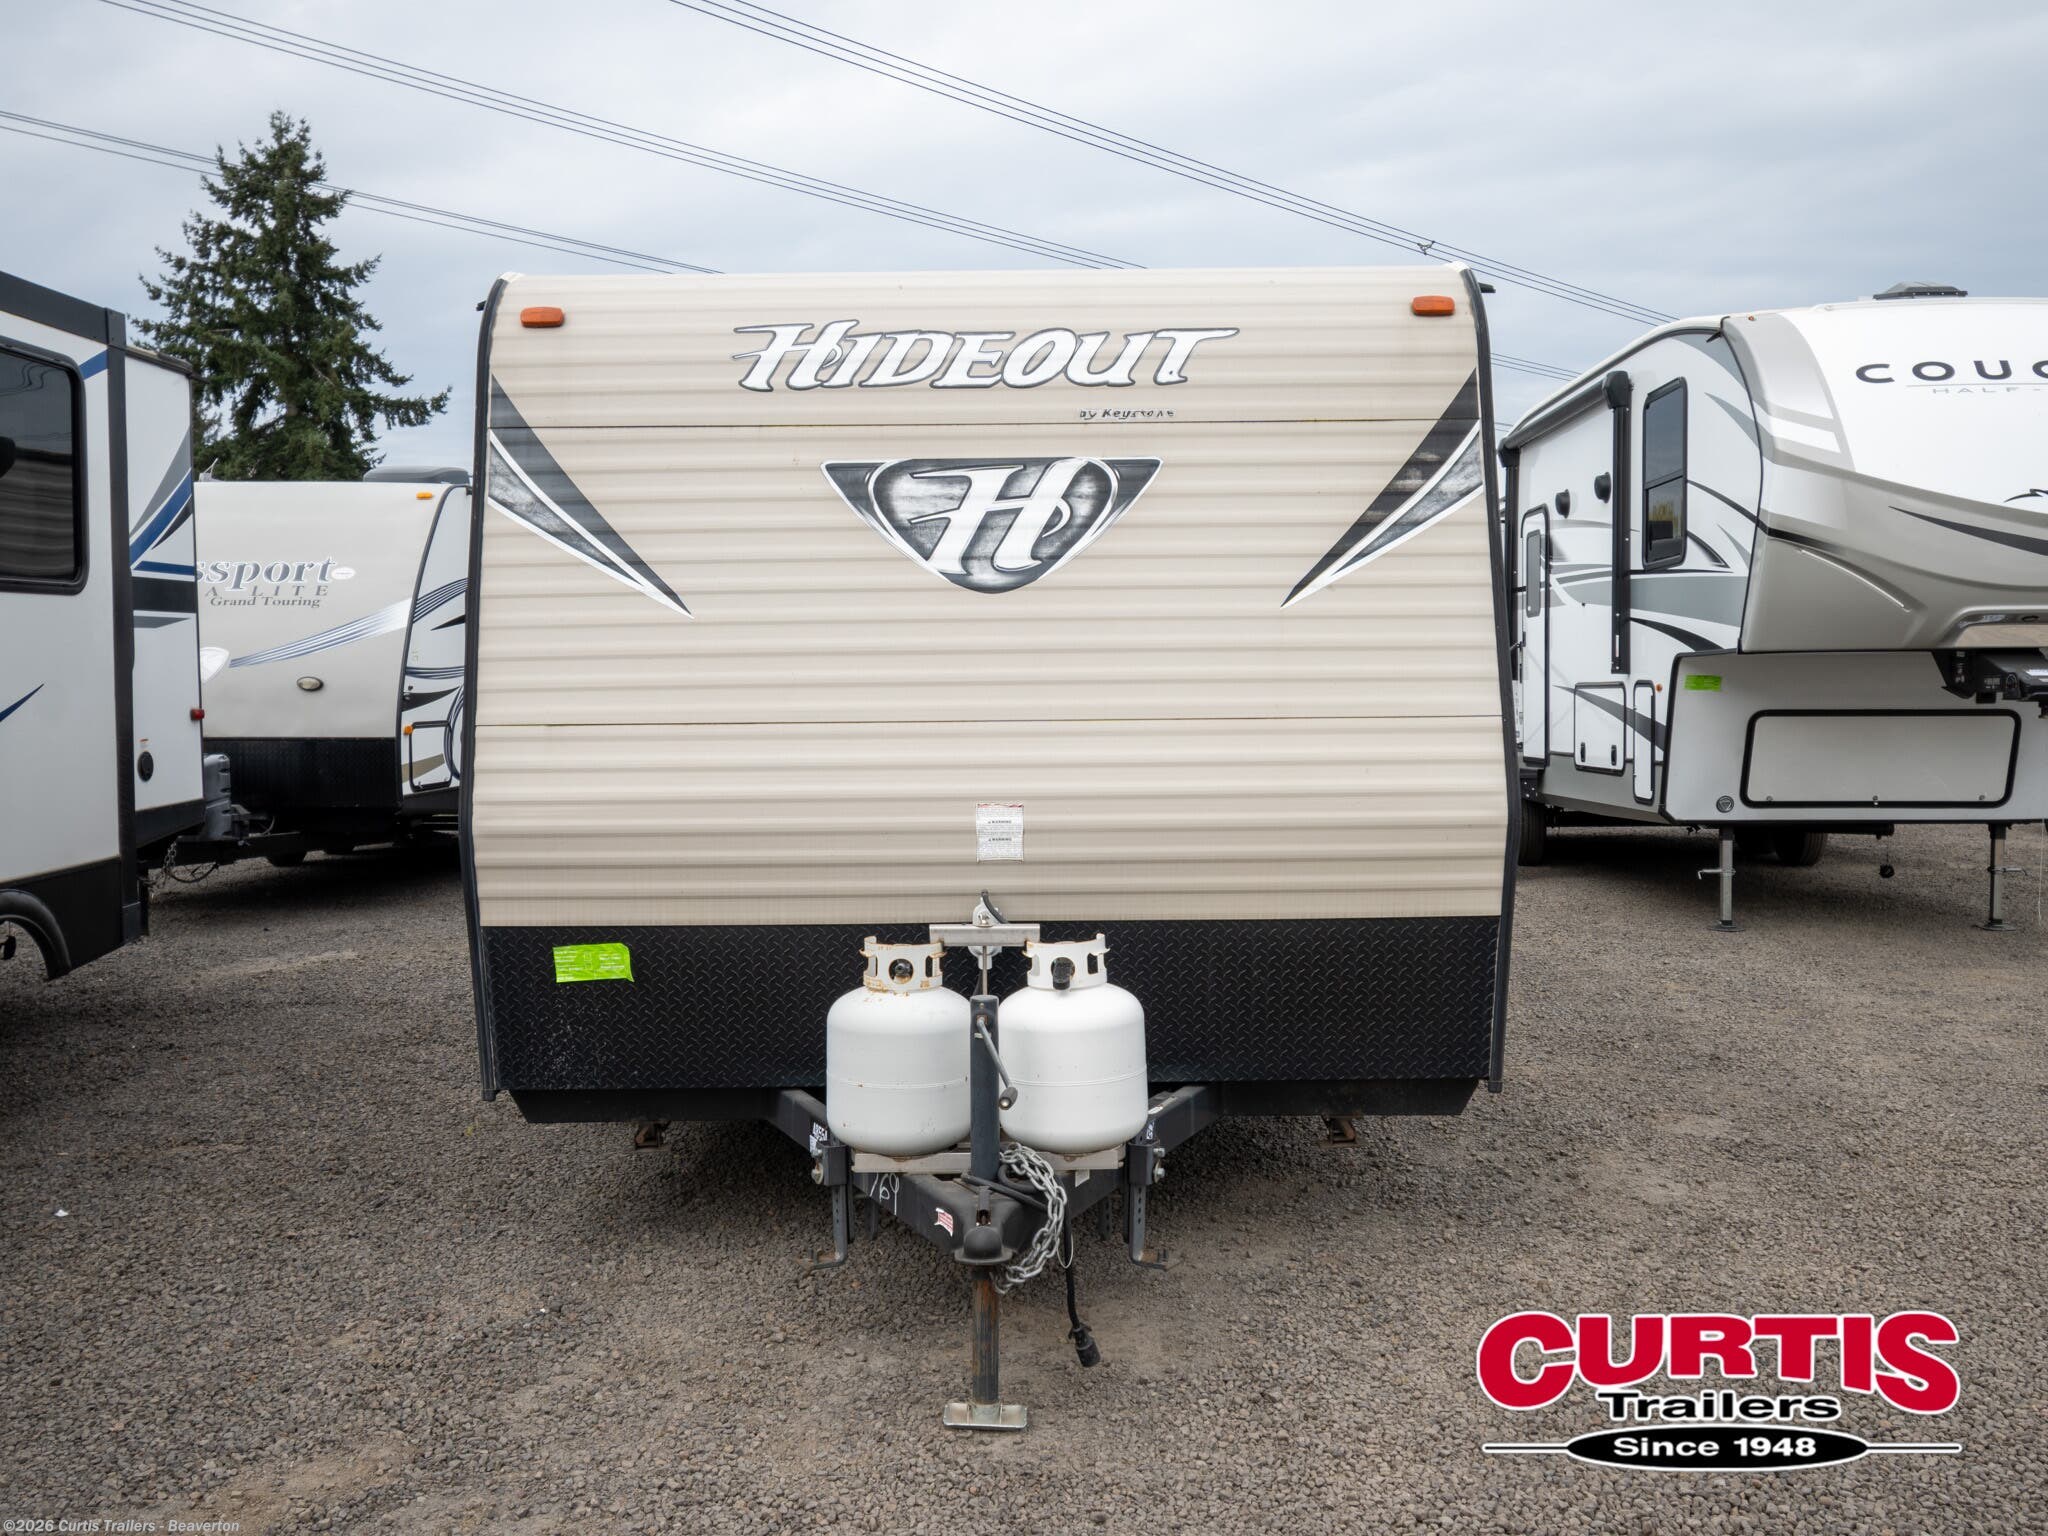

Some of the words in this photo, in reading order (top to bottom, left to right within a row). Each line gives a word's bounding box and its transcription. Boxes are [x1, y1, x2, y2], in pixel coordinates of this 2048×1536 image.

[731, 318, 1241, 393] HIDEOUT
[1079, 409, 1097, 421] by
[1101, 408, 1175, 420] Keystone
[251, 584, 329, 597] LITE
[209, 595, 256, 607] Grand
[261, 596, 321, 609] Touring
